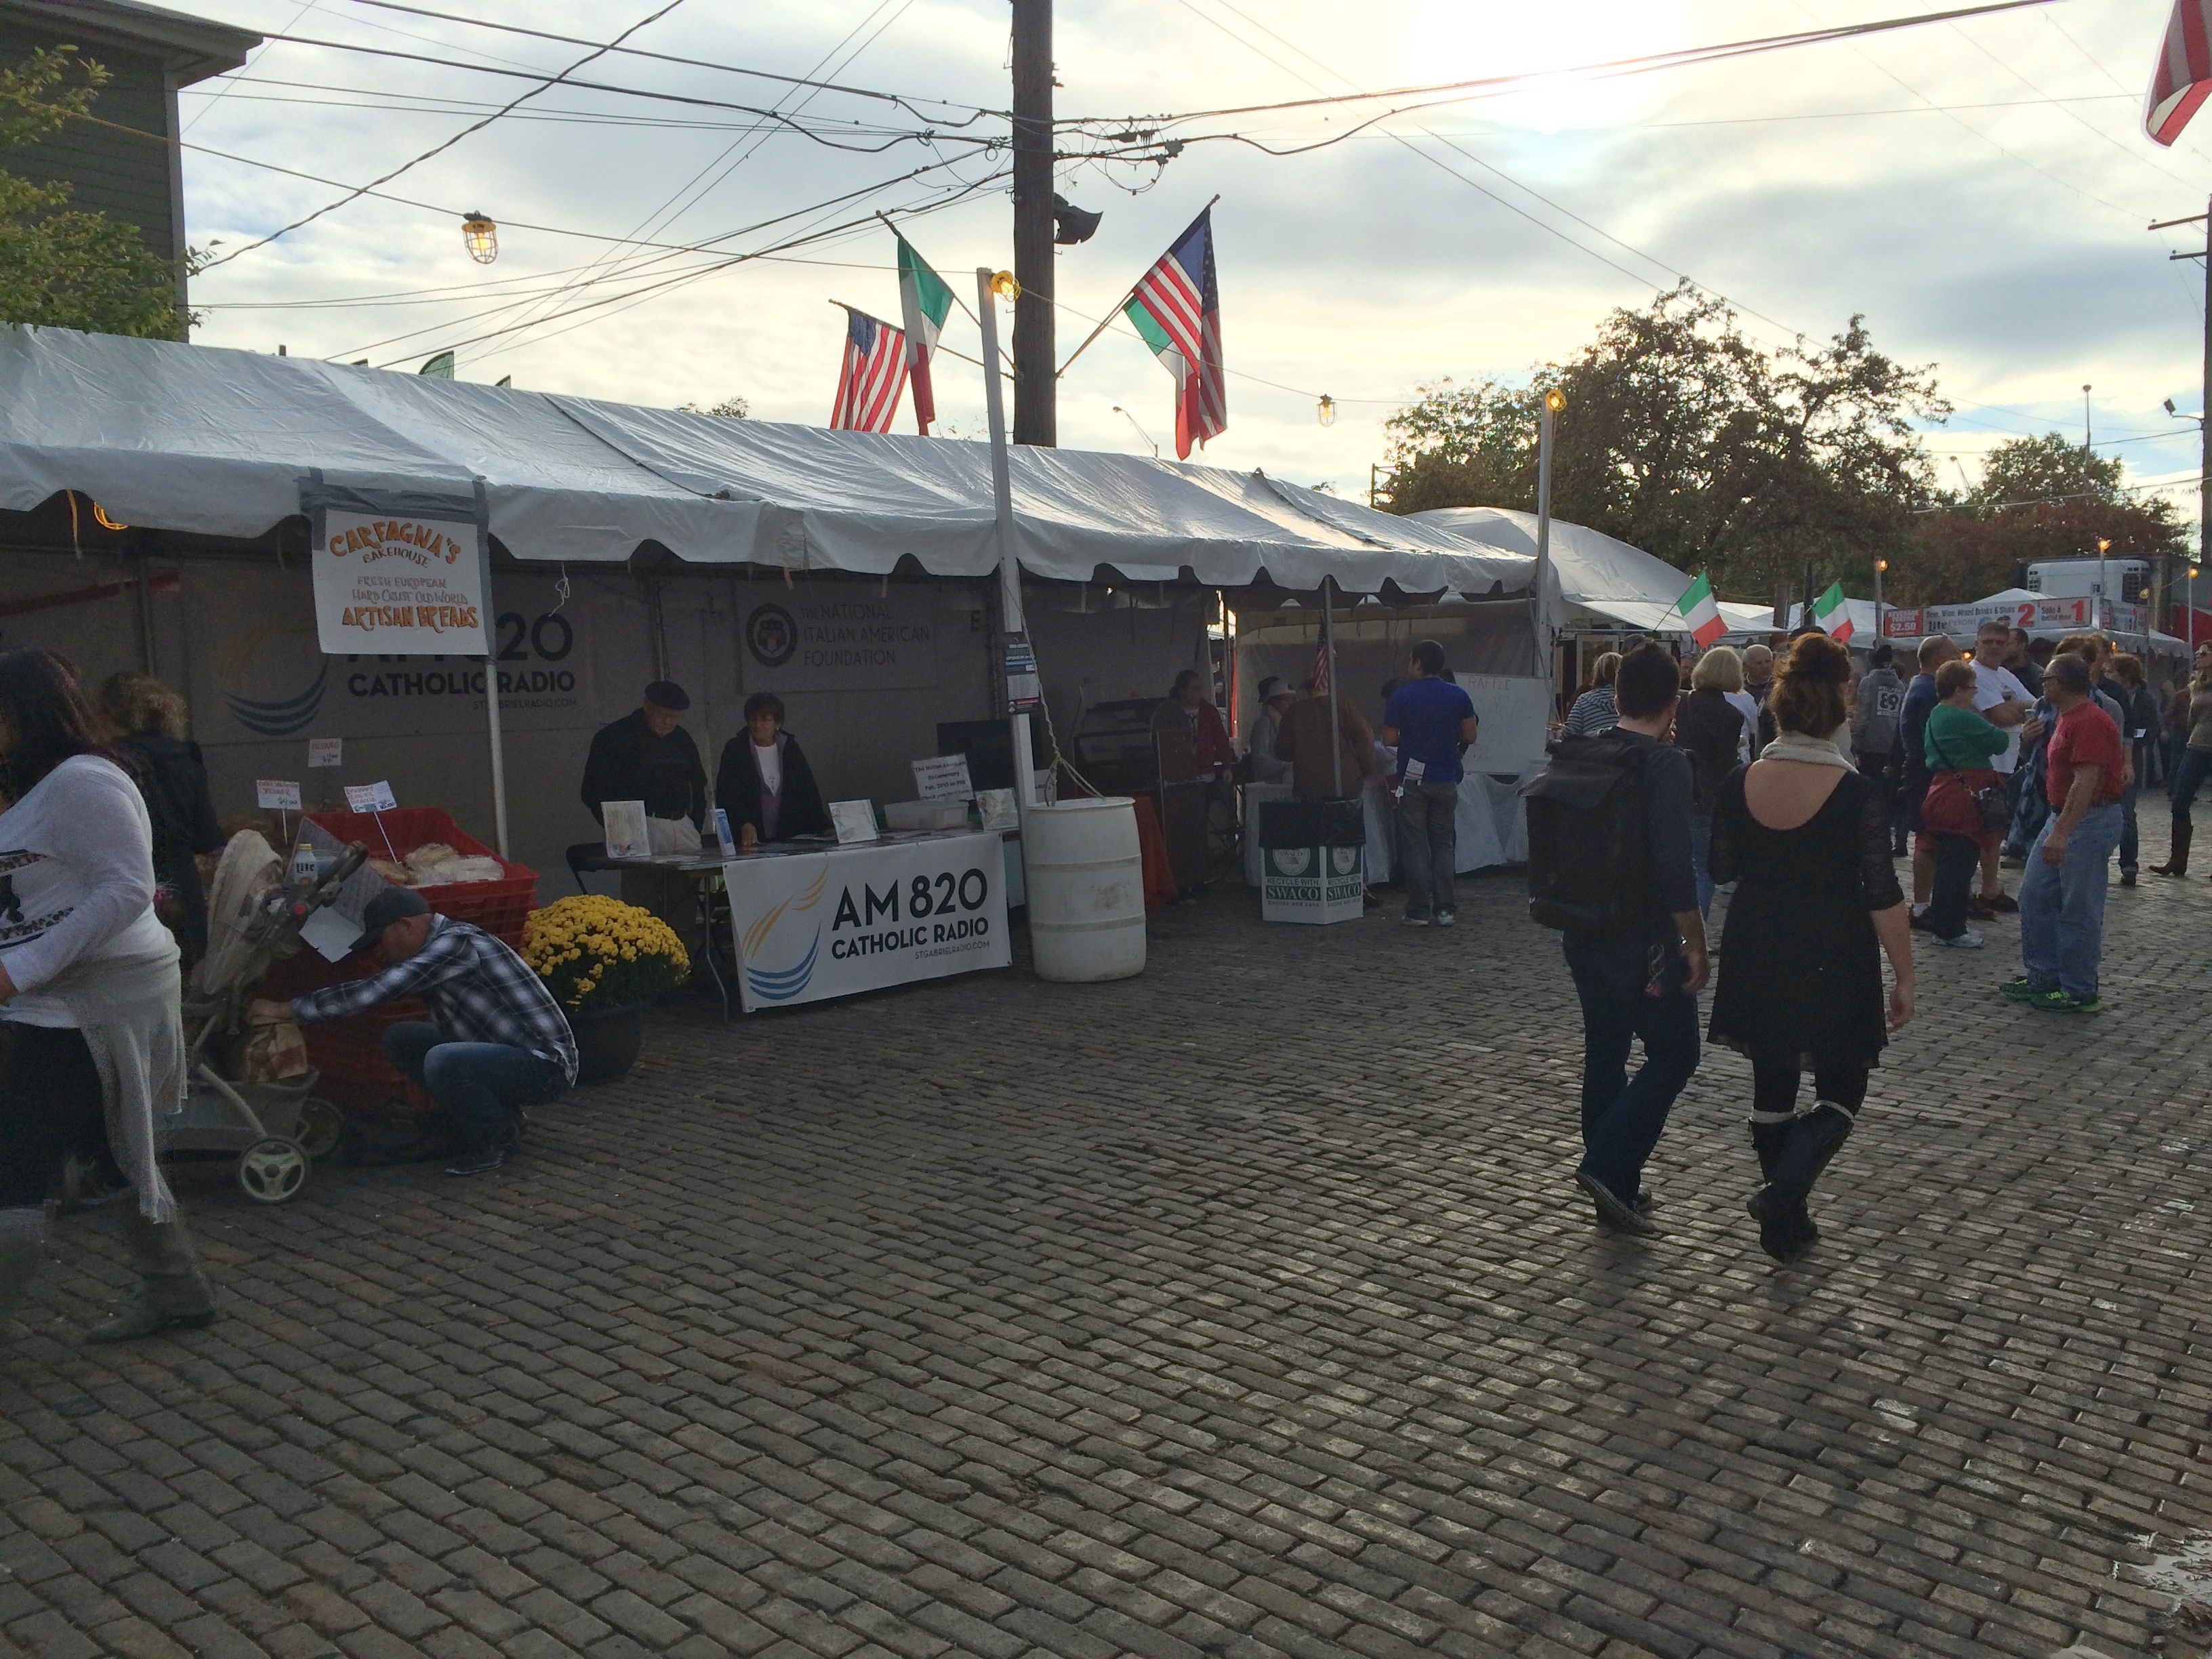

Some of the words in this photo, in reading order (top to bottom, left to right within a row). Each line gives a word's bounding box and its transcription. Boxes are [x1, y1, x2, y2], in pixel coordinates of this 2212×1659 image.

[330, 521, 462, 564] CARFAGNA'S
[363, 547, 432, 568] BAKEHOUSE
[358, 576, 391, 587] FRESH
[395, 577, 447, 589] EUROPEAN
[352, 589, 380, 604] HARD
[821, 604, 893, 619] NATIONAL
[2071, 600, 2084, 622] 1
[342, 606, 415, 631] ARTISAN
[417, 606, 478, 634] BREADS
[1890, 622, 1917, 632] $2.50
[468, 612, 572, 662] 20
[804, 626, 855, 642] ITALIAN
[861, 626, 930, 642] AMERICAN
[804, 649, 896, 667] FOUNDATION
[347, 670, 487, 697] CATHOLIC
[497, 670, 575, 693] RADIO
[1468, 678, 1511, 691] RAFFLE
[474, 698, 576, 710] STBRIELRADIO.COM
[1880, 693, 1899, 710] 89
[296, 862, 315, 874] Lite
[1328, 877, 1349, 886] RECYCLE
[832, 879, 899, 931] AM
[909, 868, 988, 919] 820
[1267, 886, 1319, 900] SWACO
[1328, 883, 1360, 901] SWACO
[832, 926, 928, 960] CATHOLIC
[933, 917, 989, 943] RADIO
[915, 941, 990, 960] STGABRIELRADIO.COM
